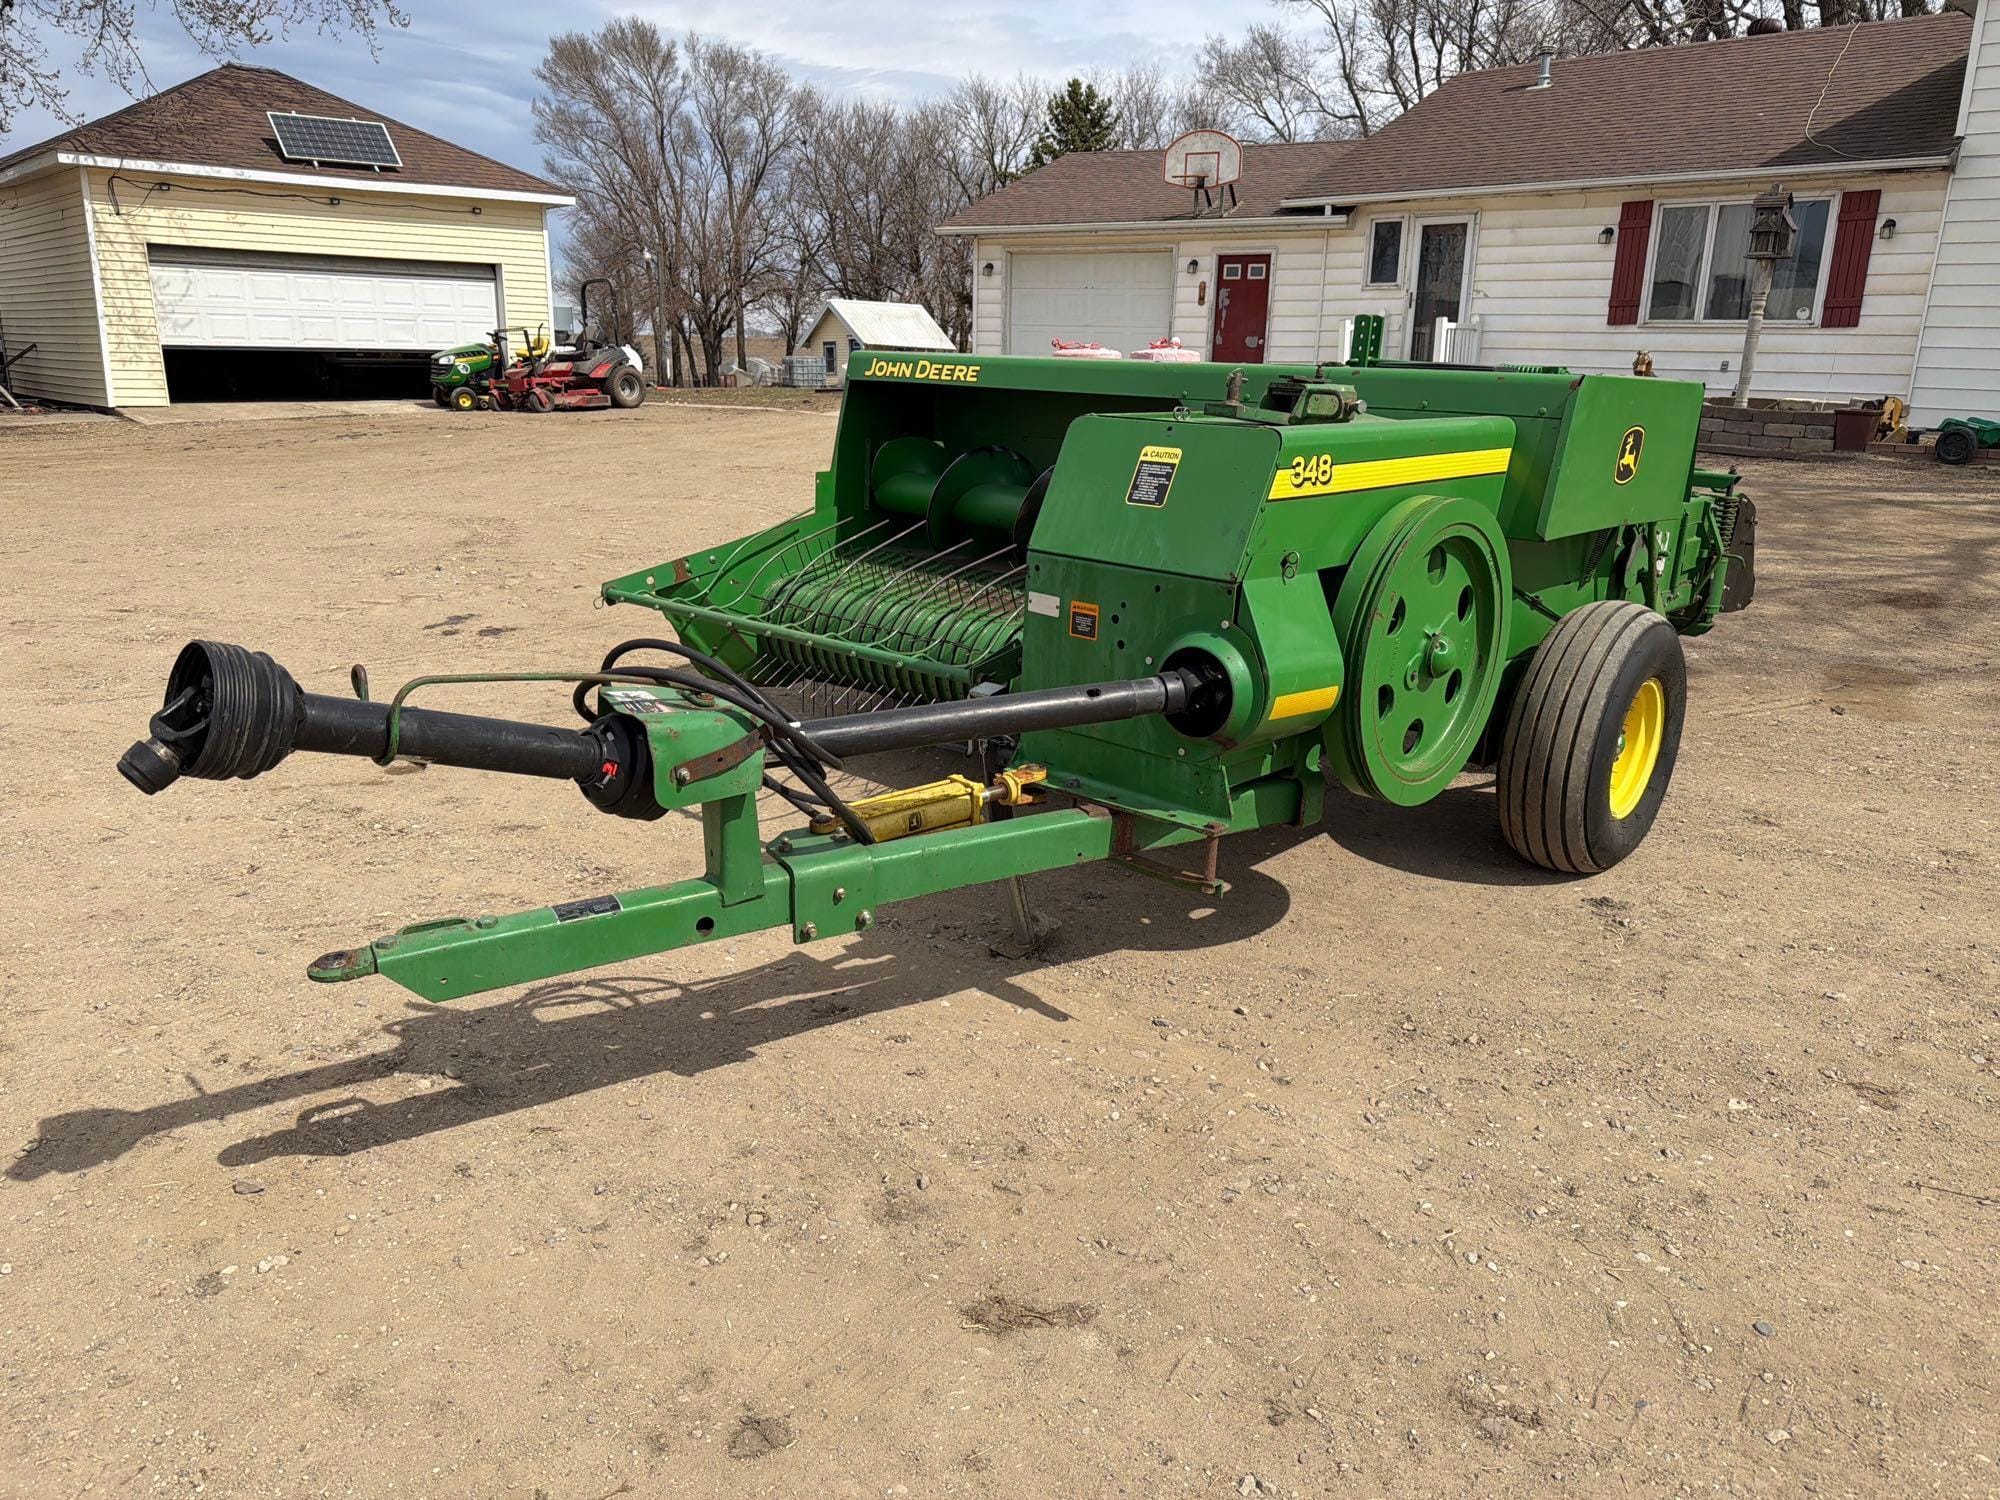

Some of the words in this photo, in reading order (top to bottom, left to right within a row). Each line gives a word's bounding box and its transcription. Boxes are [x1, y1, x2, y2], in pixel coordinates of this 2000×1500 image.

[864, 358, 913, 378] JOHN
[915, 360, 980, 382] DEERE
[1150, 450, 1179, 460] CAUTION
[1290, 453, 1332, 488] 348
